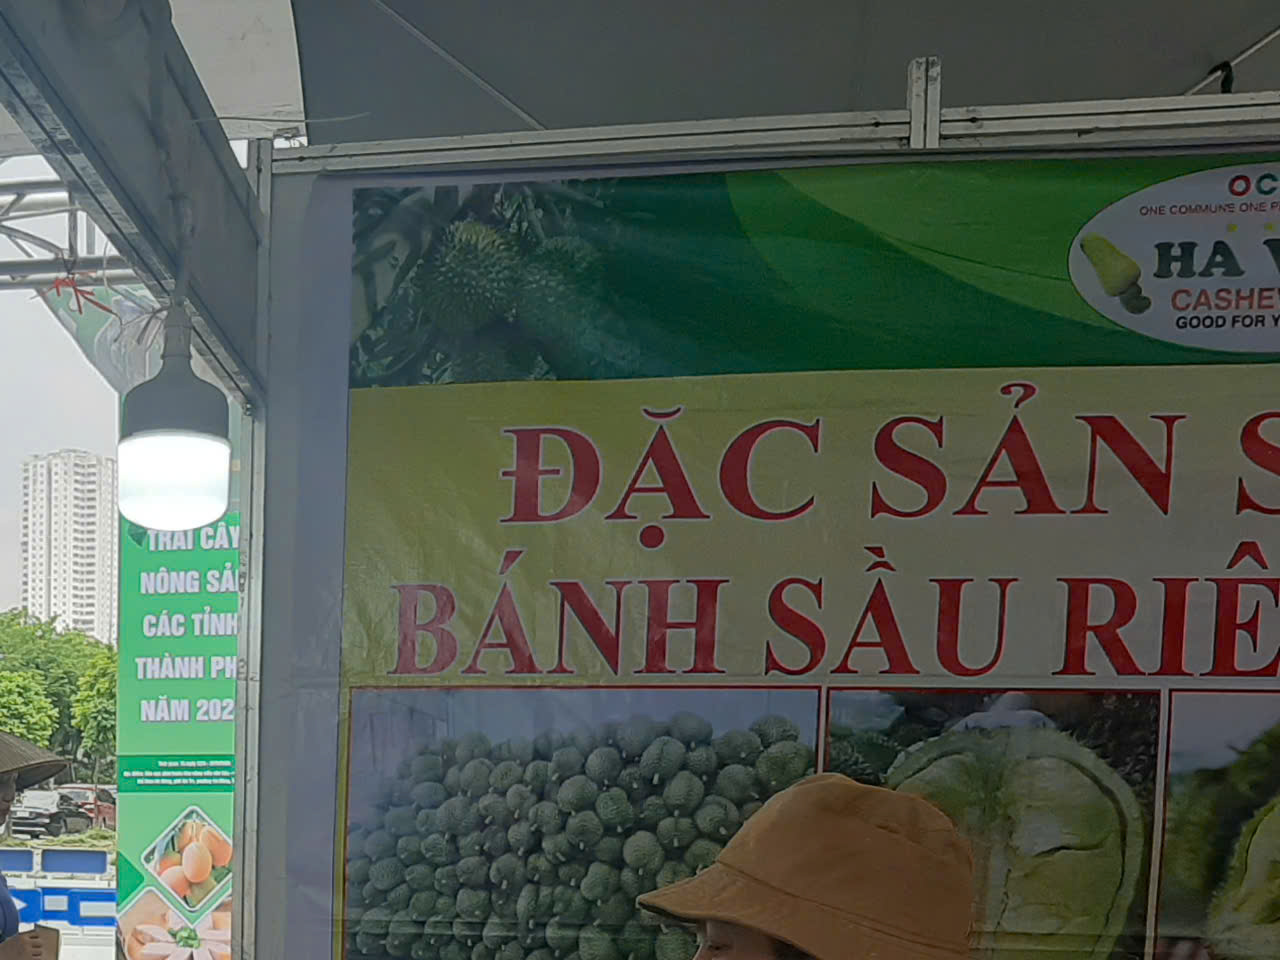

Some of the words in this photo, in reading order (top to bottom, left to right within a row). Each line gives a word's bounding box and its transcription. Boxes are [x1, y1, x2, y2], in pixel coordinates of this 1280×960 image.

[1228, 173, 1280, 197] OC
[1139, 206, 1166, 216] ONE
[1170, 204, 1235, 215] COMMUNE
[1240, 202, 1267, 213] ONE
[1153, 240, 1245, 279] HA
[1176, 316, 1226, 329] GOOD
[1231, 315, 1265, 328] FOR
[499, 403, 823, 549] ĐẶC
[871, 382, 1187, 519] SẢN
[200, 522, 240, 549] CÂY
[140, 567, 200, 594] NÔNG
[390, 548, 729, 677] BÁNH
[765, 543, 1019, 677] SẦU
[1055, 538, 1280, 677] RIÊ
[143, 610, 185, 637] CÁC
[191, 606, 238, 635] TỈNH
[135, 653, 204, 680] THÀNH
[210, 656, 237, 678] PH
[140, 696, 189, 721] NĂM
[196, 699, 235, 720] 202
